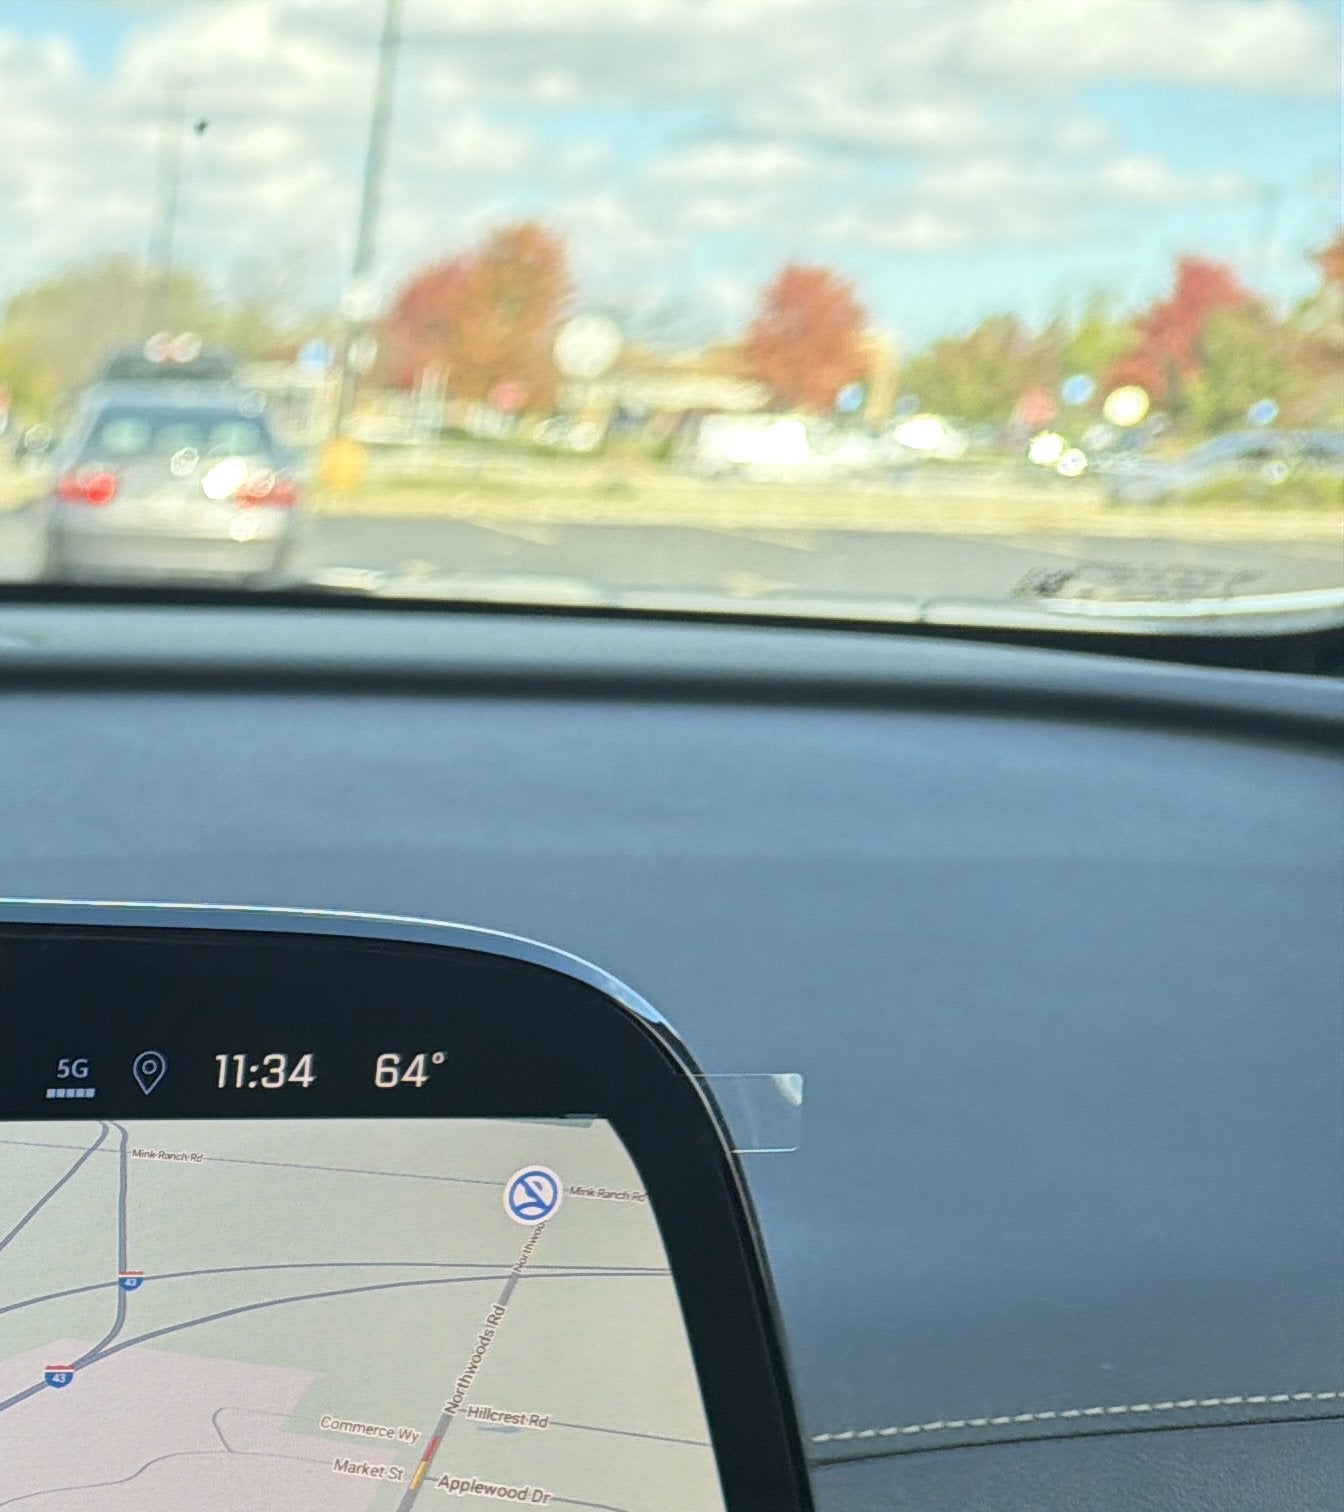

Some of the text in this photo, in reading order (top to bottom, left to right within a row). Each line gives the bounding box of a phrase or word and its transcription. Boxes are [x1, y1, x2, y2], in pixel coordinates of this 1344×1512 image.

[57, 1058, 89, 1079] 5G
[215, 1053, 315, 1089] 11:34
[375, 1051, 445, 1089] 64°
[132, 1149, 204, 1162] Mink Ranch Rd
[444, 1305, 507, 1414] Northwoods Rd
[52, 1374, 66, 1384] 43
[320, 1416, 419, 1445] Commerce Wy
[468, 1406, 549, 1429] Hillcrest Rd
[334, 1458, 404, 1481] Market St
[438, 1475, 551, 1504] Applewood Dr
